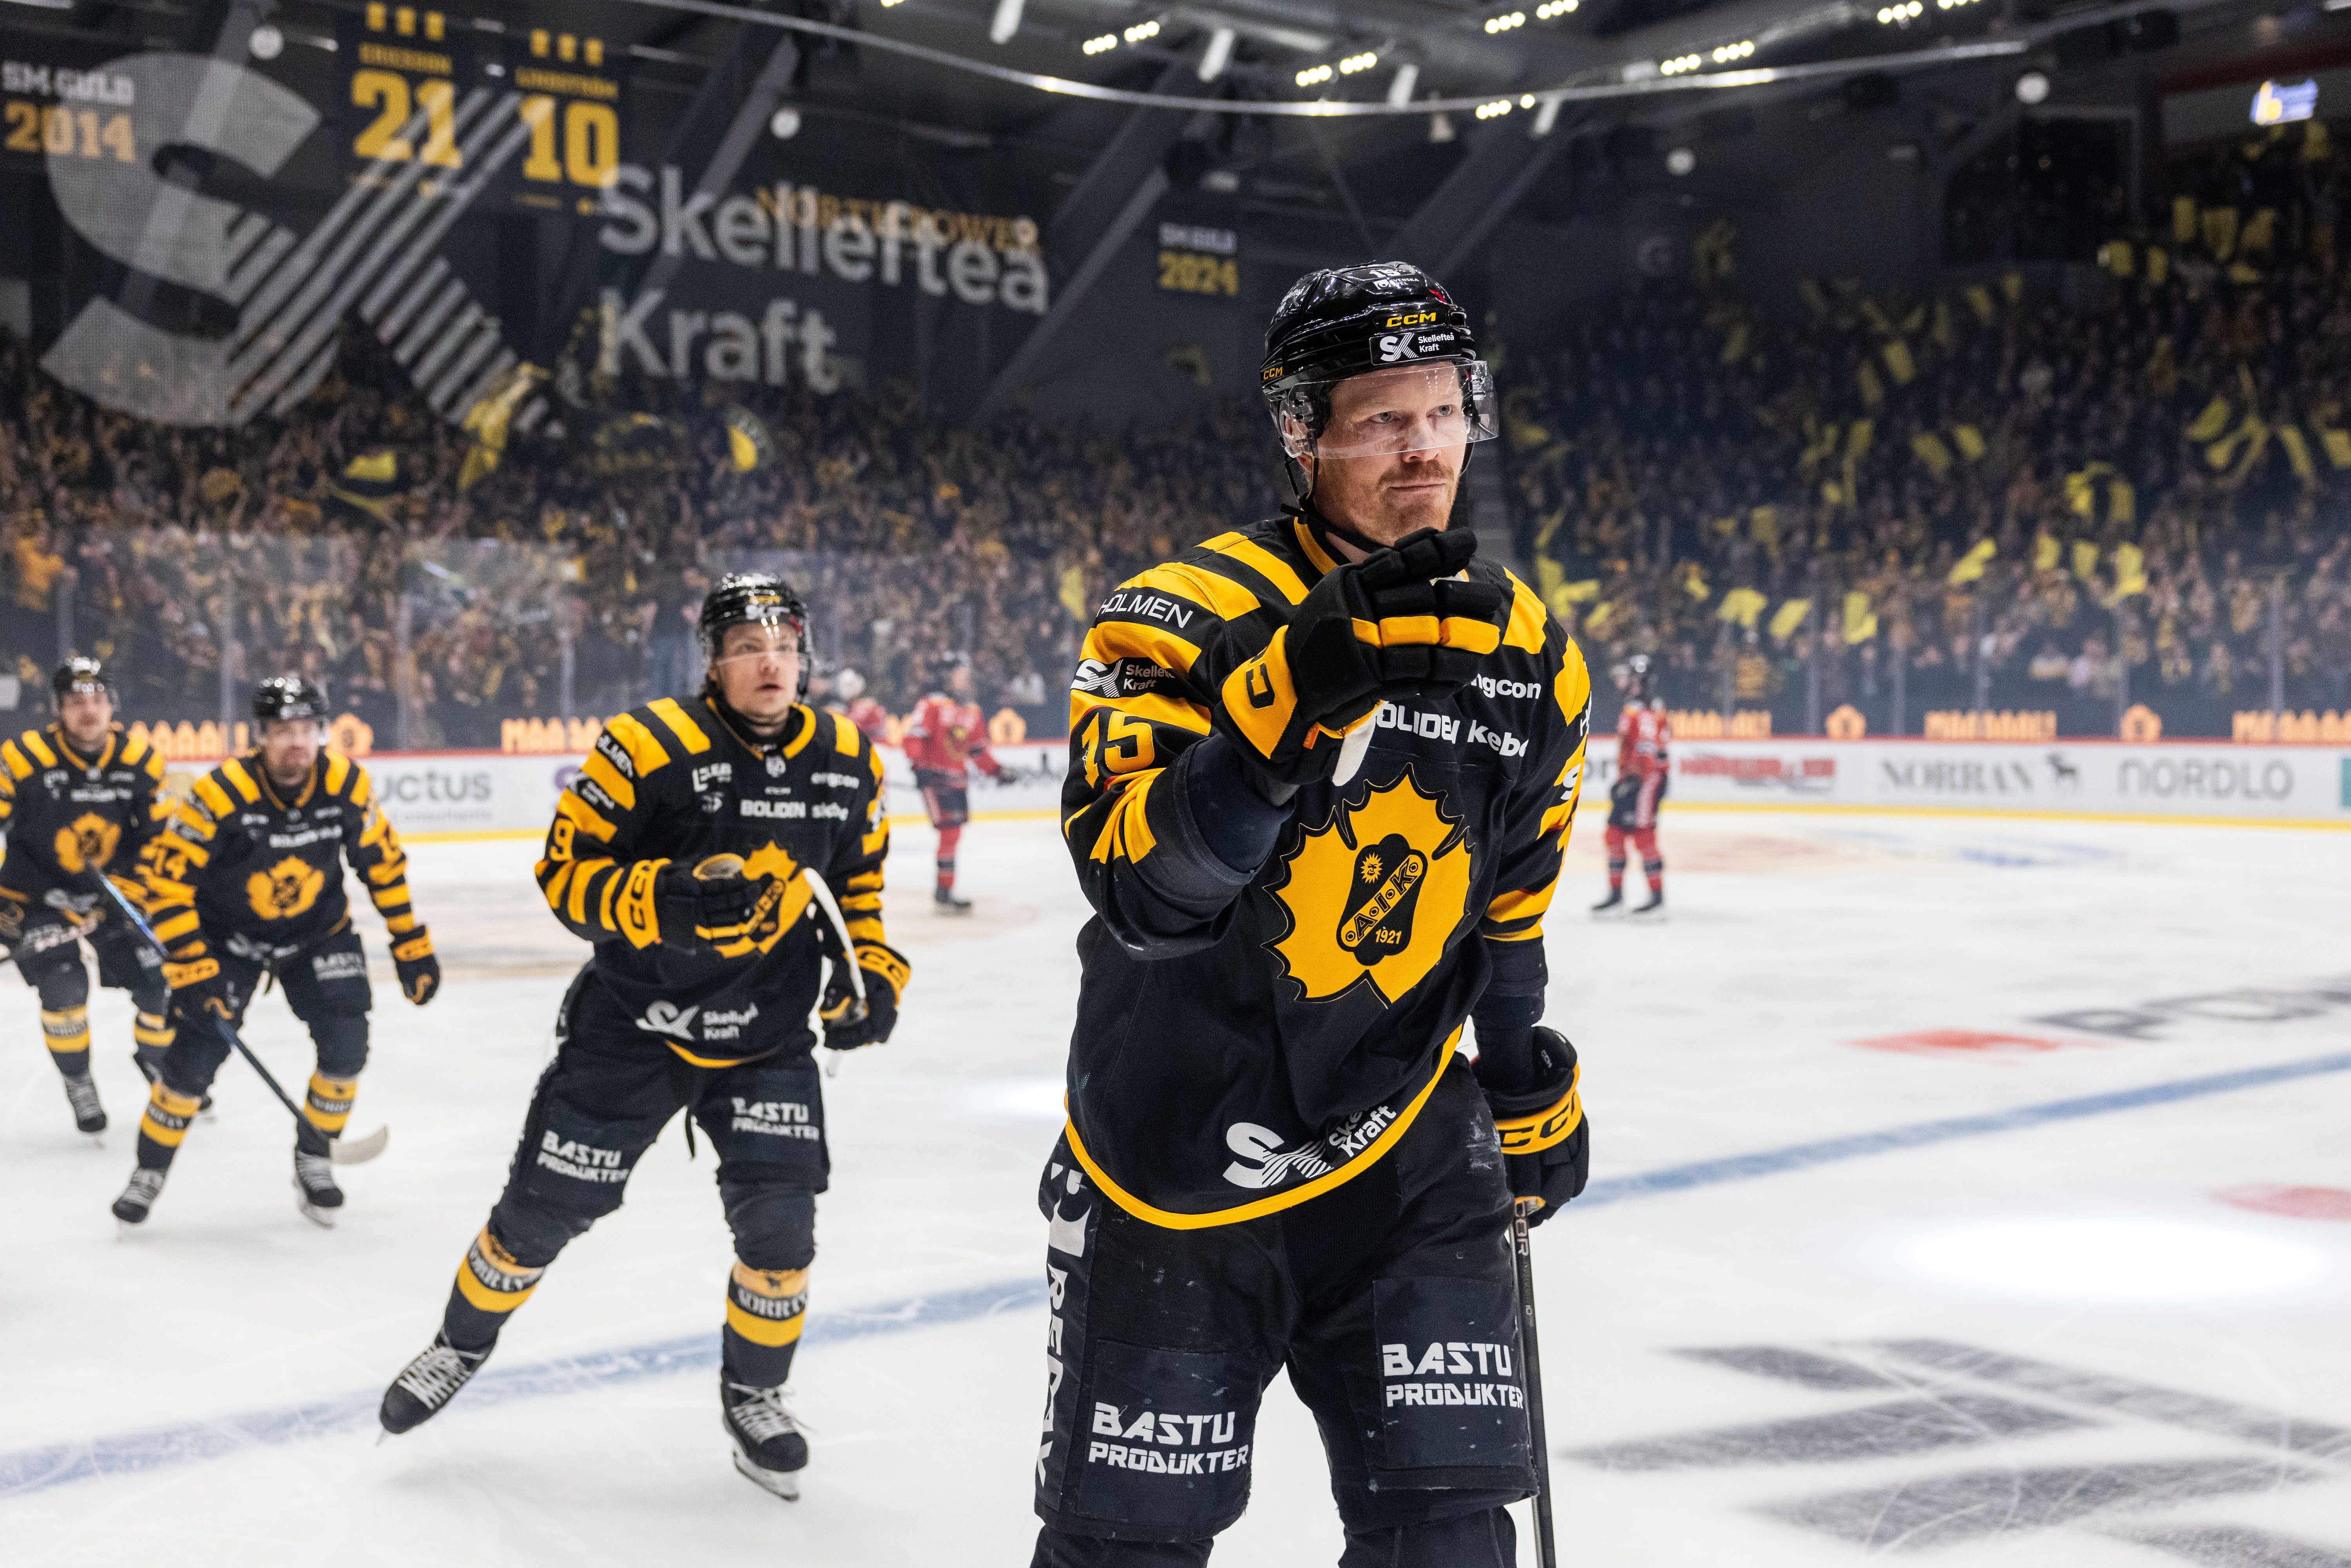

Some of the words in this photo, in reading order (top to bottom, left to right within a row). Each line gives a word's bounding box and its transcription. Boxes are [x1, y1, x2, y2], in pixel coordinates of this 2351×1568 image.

[5, 101, 136, 163] 2014
[352, 70, 462, 169] 21
[520, 95, 620, 187] 10
[1369, 269, 1401, 277] 15
[1387, 312, 1436, 327] CCM
[600, 287, 839, 395] Kraft
[1418, 332, 1454, 344] Skellefteå
[1419, 344, 1439, 352] Kraft
[1263, 367, 1283, 380] CCM
[1096, 594, 1194, 628] HOLMEN
[1123, 679, 1157, 690] Kraft
[1082, 710, 1155, 789] 15
[374, 770, 493, 803] uctus
[1375, 929, 1402, 945] 1921
[1338, 1105, 1396, 1158] Kraft
[541, 1129, 623, 1169] BASTU
[1382, 1342, 1512, 1377] BASTU
[1386, 1383, 1524, 1409] PRODUKTER
[1092, 1401, 1235, 1446] BASTU
[1088, 1441, 1249, 1474] PRODUKTER
